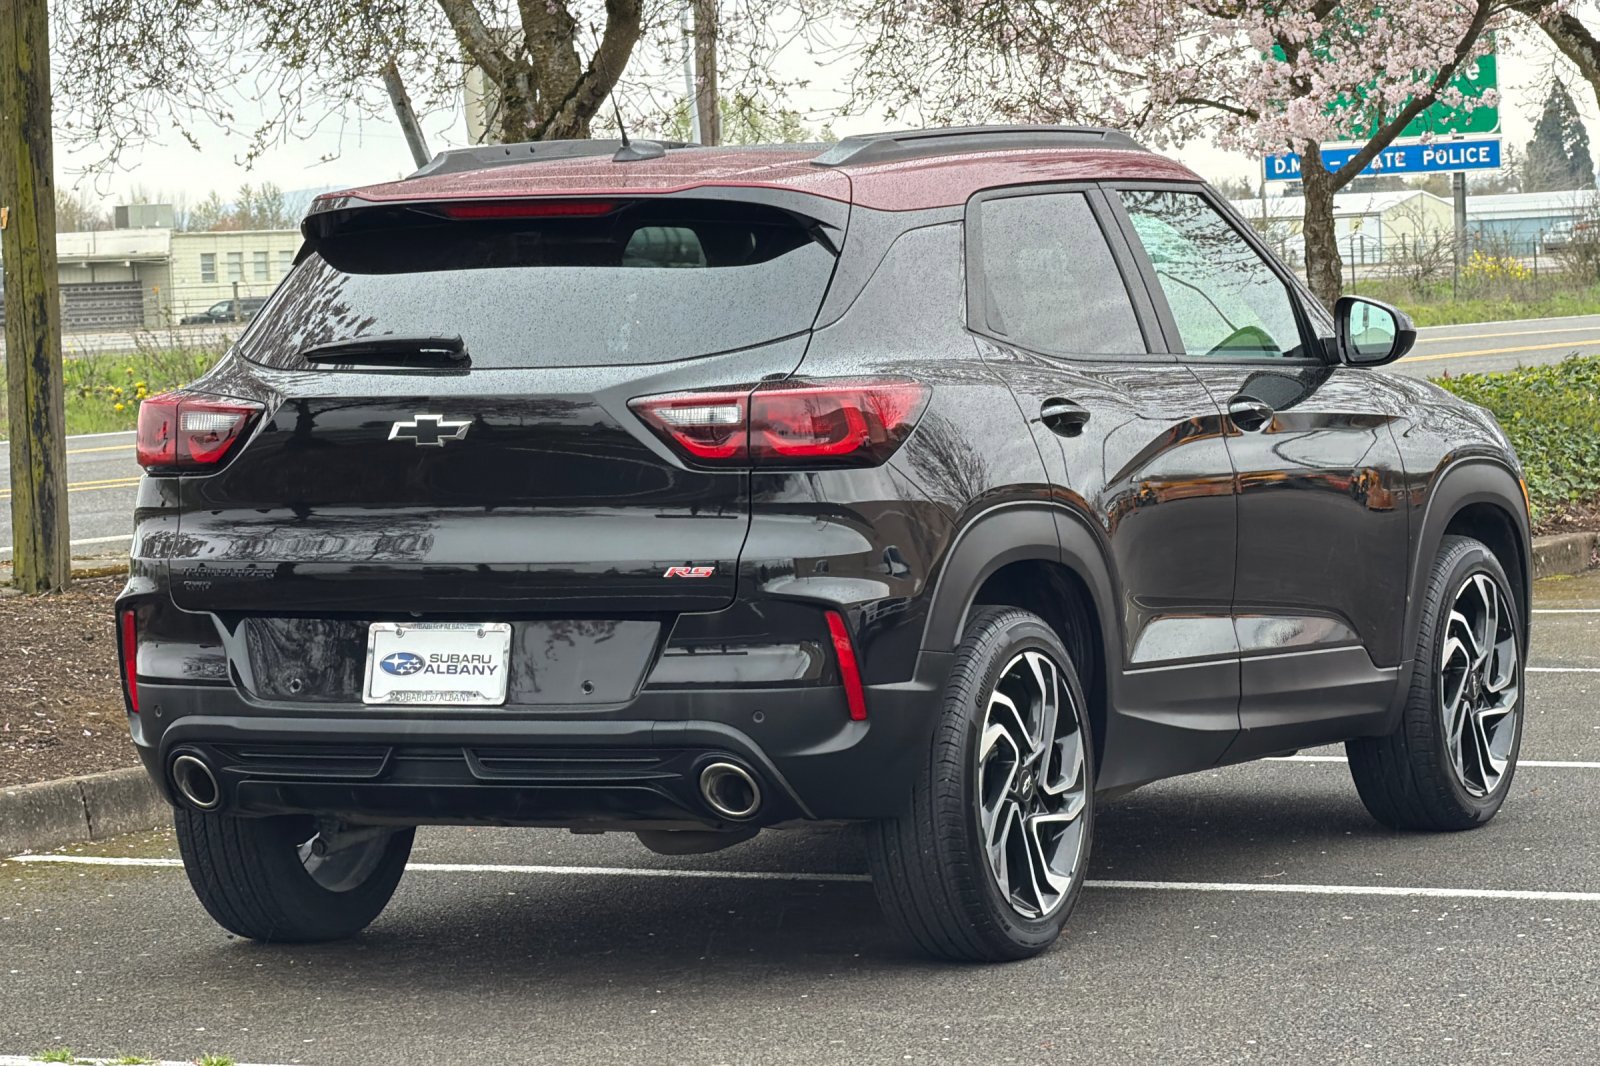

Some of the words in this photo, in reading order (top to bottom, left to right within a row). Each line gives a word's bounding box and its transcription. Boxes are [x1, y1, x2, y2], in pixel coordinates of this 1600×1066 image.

[1347, 151, 1406, 170] ATE
[1422, 146, 1491, 166] POLICE
[663, 566, 715, 577] RS
[429, 653, 492, 665] SUBARU
[423, 664, 498, 676] ALBANY
